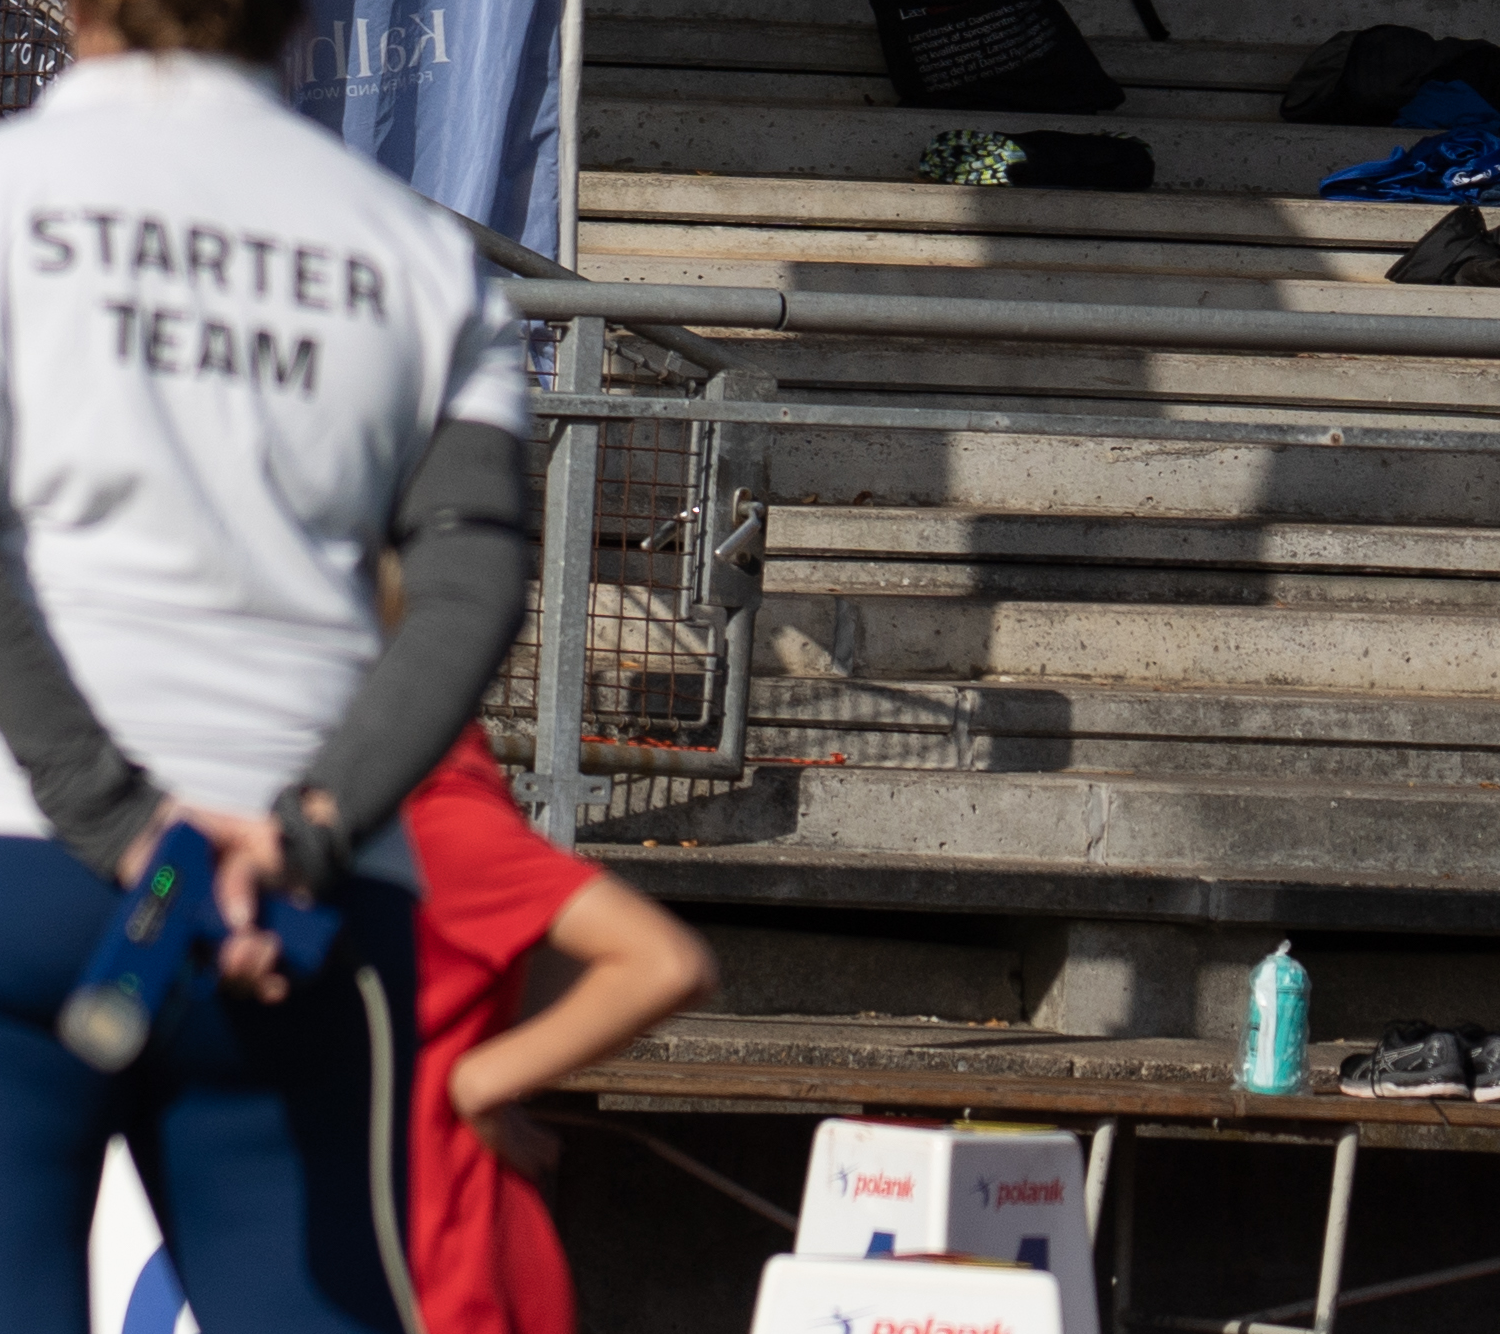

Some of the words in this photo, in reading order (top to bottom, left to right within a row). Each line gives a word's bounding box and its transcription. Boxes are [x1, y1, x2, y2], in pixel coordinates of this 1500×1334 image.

[28, 208, 390, 324] STARTER
[102, 296, 321, 400] TEAM
[853, 1171, 916, 1202] polanik
[996, 1175, 1066, 1213] polanik
